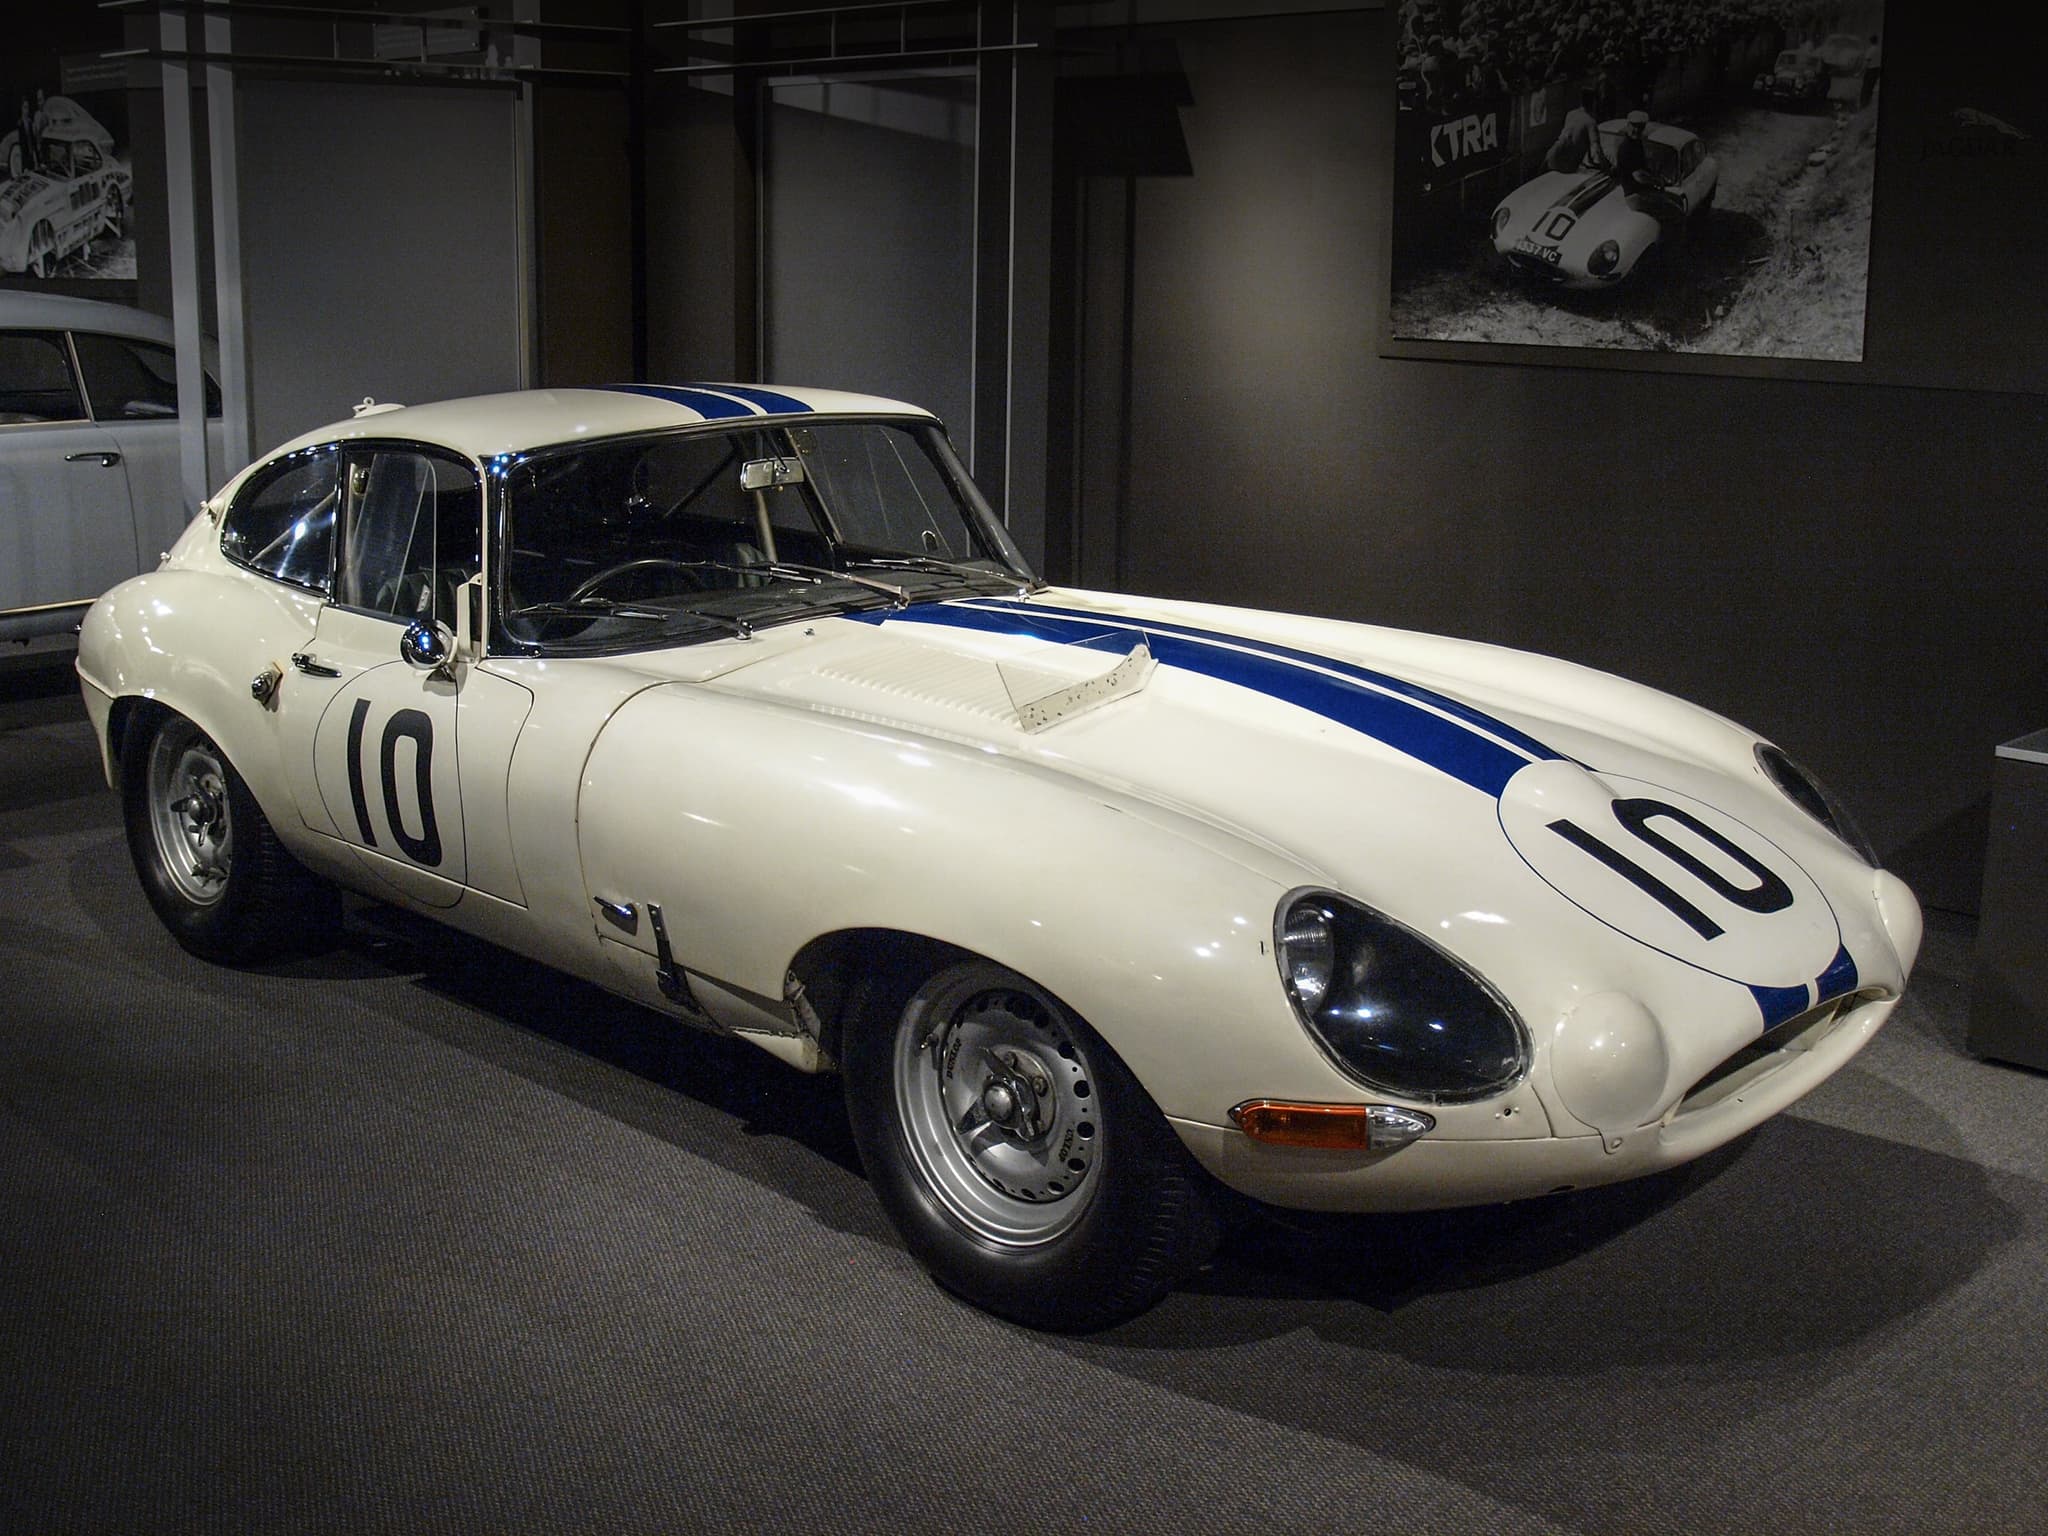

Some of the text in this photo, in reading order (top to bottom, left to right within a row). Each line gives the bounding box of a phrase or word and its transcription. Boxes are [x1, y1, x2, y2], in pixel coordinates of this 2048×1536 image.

[1532, 211, 1576, 241] 10
[347, 698, 442, 868] 10
[1545, 797, 1795, 941] 10
[945, 1038, 962, 1079] DUNLOP
[1059, 1126, 1074, 1163] UNLOP
